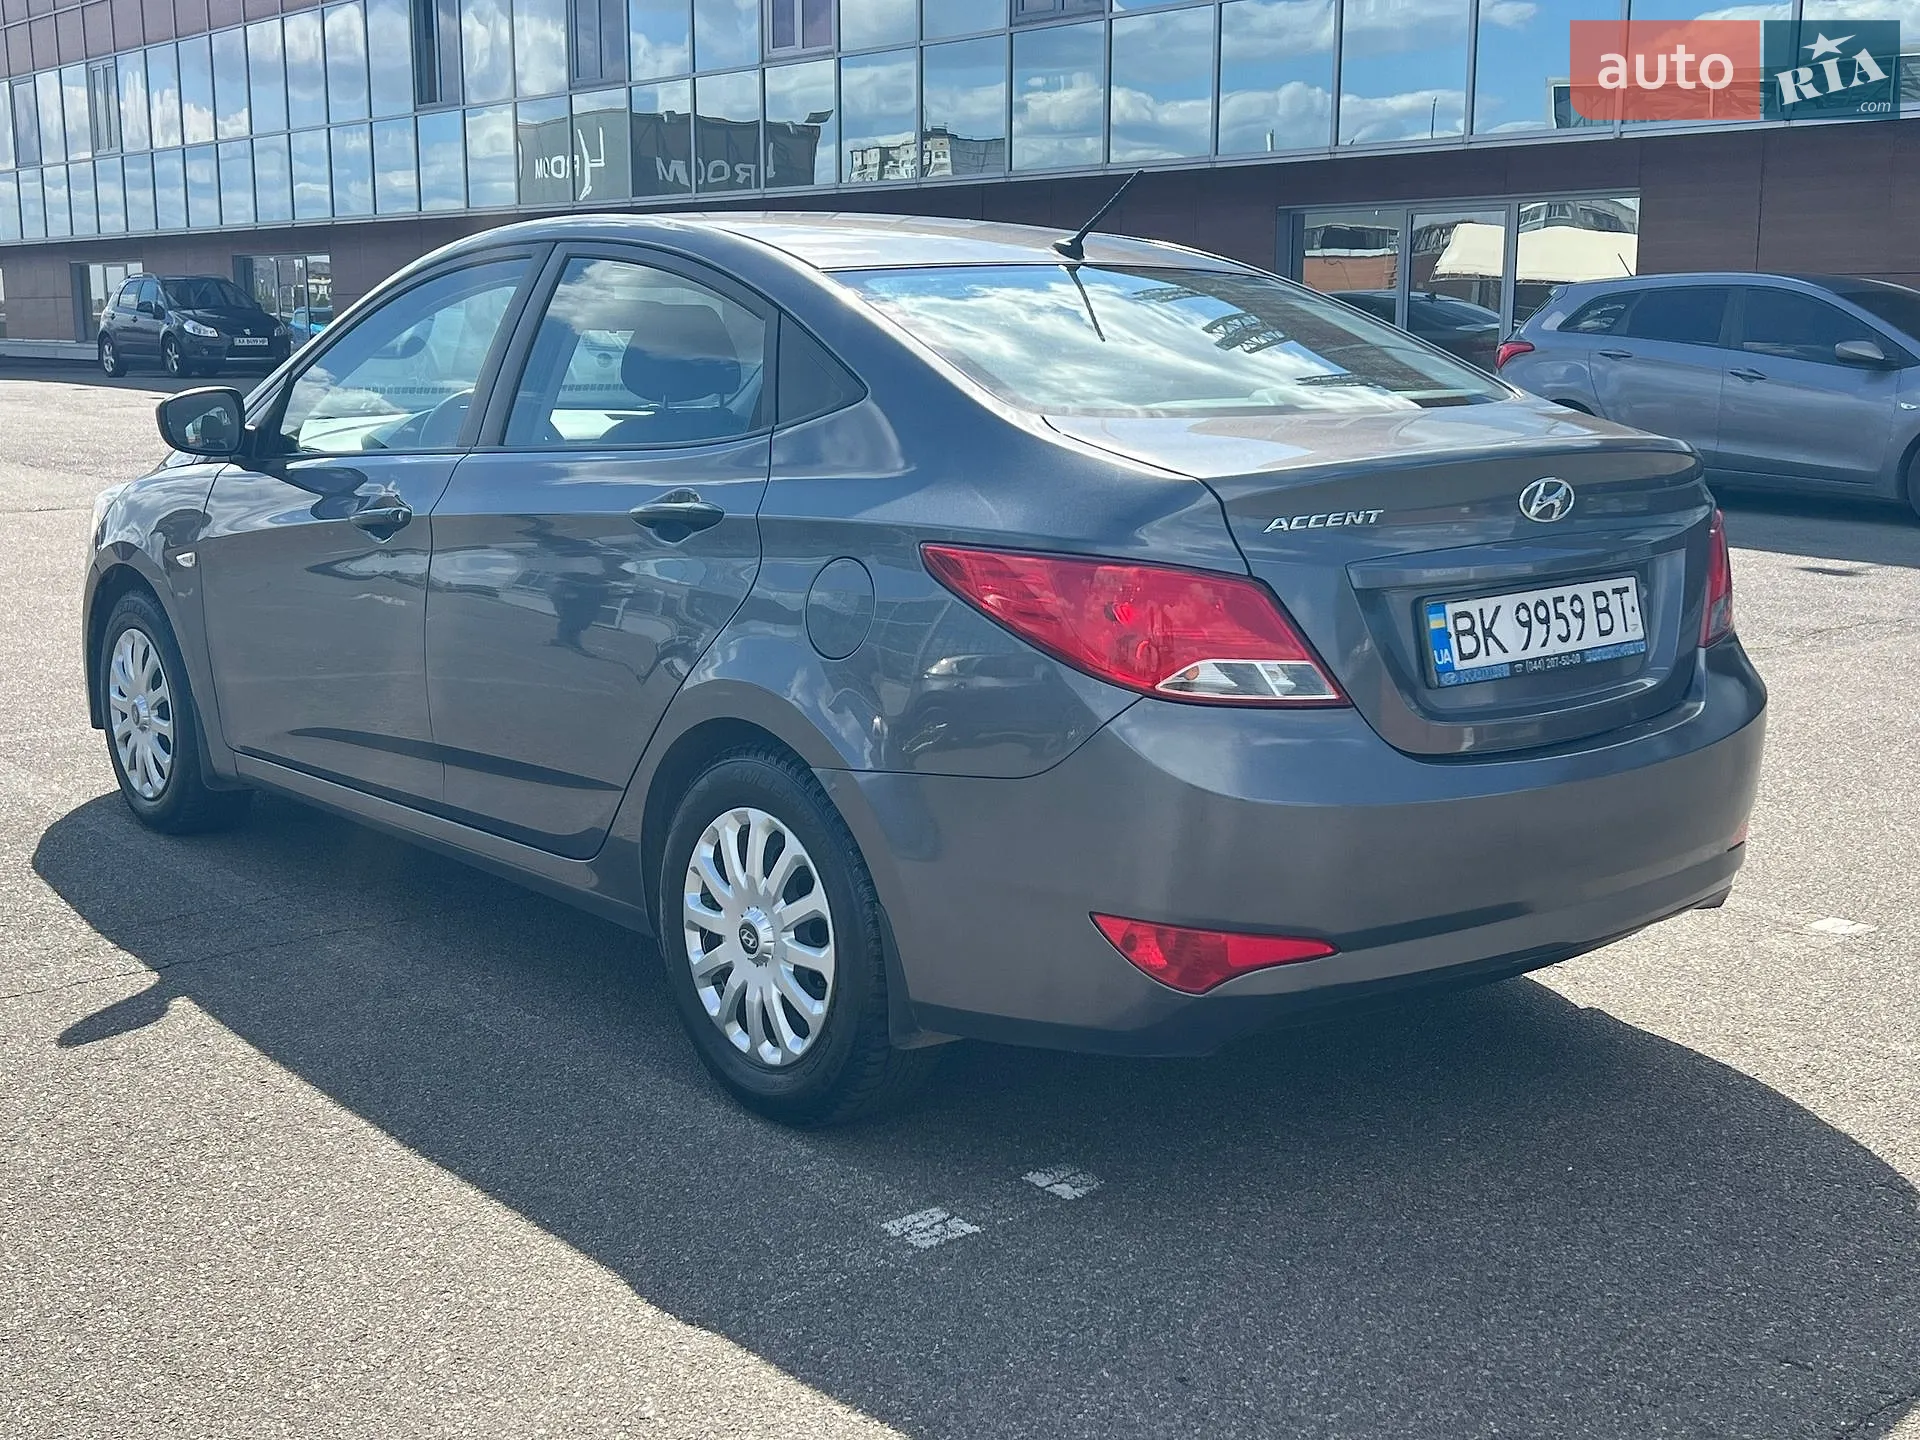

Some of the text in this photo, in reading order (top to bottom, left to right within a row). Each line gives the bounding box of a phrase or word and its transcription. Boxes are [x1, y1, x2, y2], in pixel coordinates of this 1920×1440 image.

[1262, 508, 1385, 533] ACCENT
[1452, 586, 1630, 661] BK 9959 BT
[1434, 648, 1453, 665] UA
